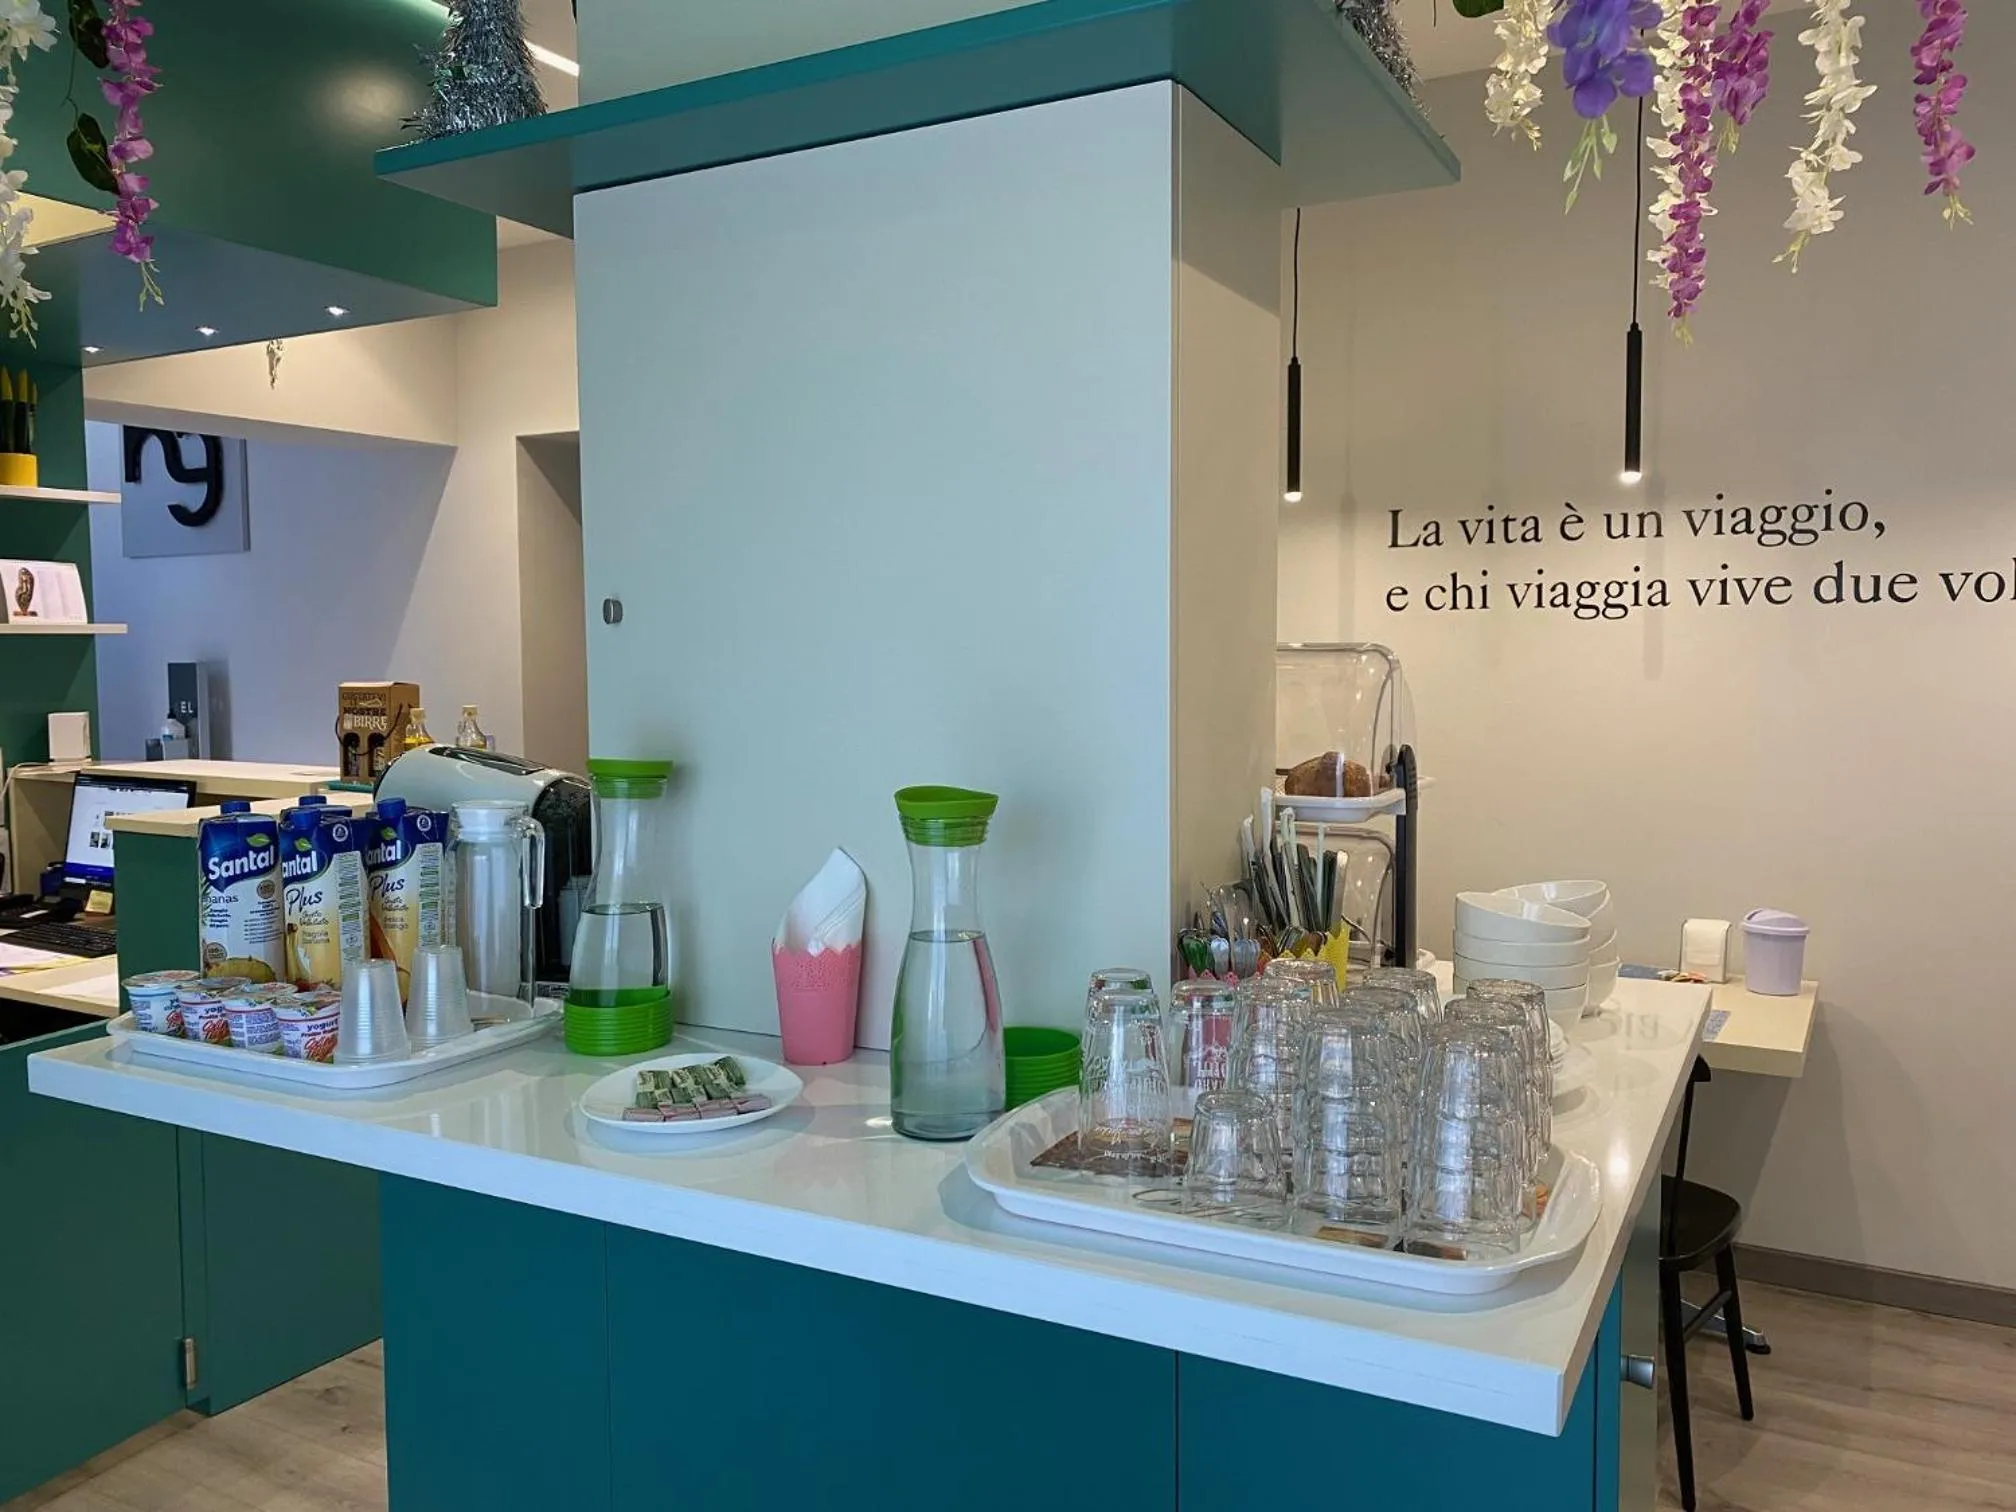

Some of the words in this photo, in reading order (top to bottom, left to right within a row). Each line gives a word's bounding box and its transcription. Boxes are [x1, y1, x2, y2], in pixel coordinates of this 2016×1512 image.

[1387, 509, 1444, 548] La
[1458, 504, 1543, 545] vita
[1559, 502, 1585, 541] è
[1603, 510, 1664, 540] un
[1682, 488, 1885, 547] viaggio,
[1386, 584, 1409, 611] e
[1425, 569, 1490, 611] chi
[1507, 567, 1670, 620] viaggia
[1687, 562, 1793, 607] vive
[1813, 560, 1918, 604] due
[208, 845, 274, 880] Santal
[281, 850, 318, 878] antal
[286, 886, 323, 916] Plus
[368, 873, 405, 900] Plus
